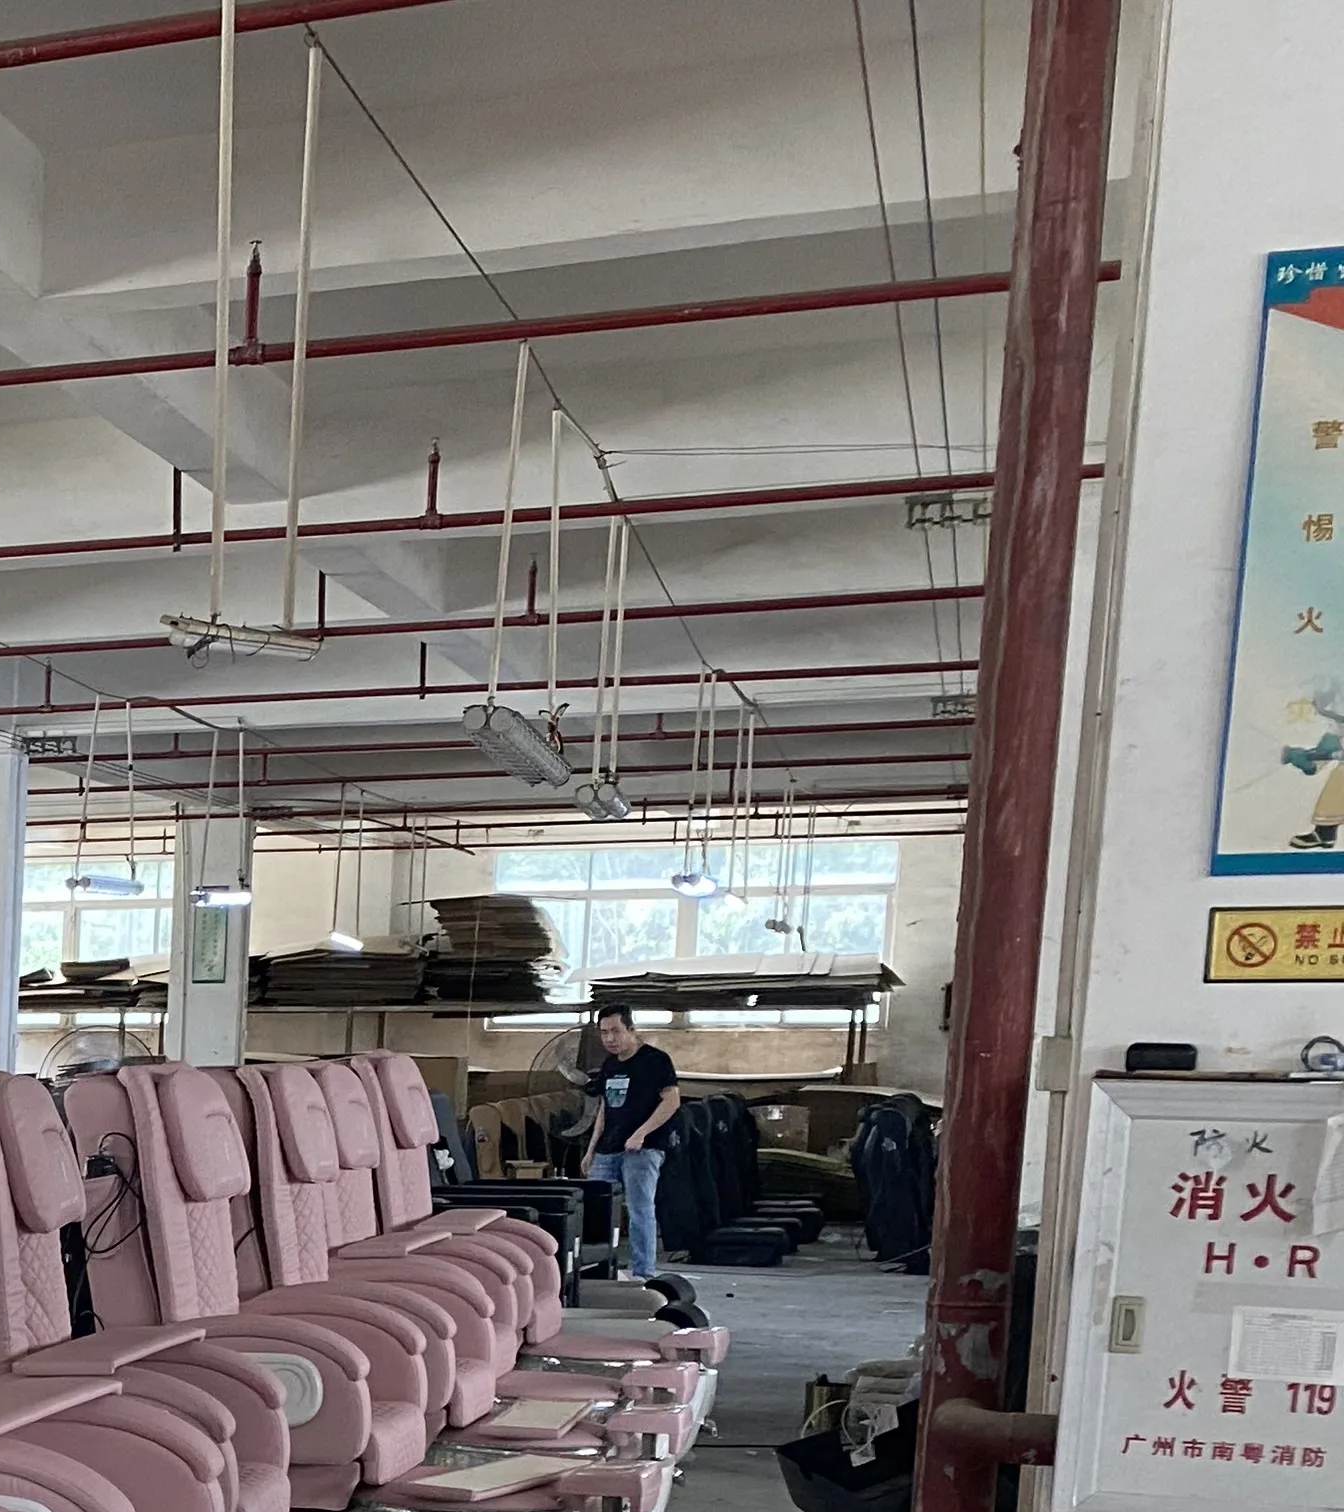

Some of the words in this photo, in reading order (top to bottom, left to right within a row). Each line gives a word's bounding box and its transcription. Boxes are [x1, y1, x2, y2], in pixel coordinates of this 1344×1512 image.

[1295, 954, 1319, 966] NO
[1287, 1382, 1337, 1415] 119
[1120, 1433, 1328, 1468] 广州市南粤消防
